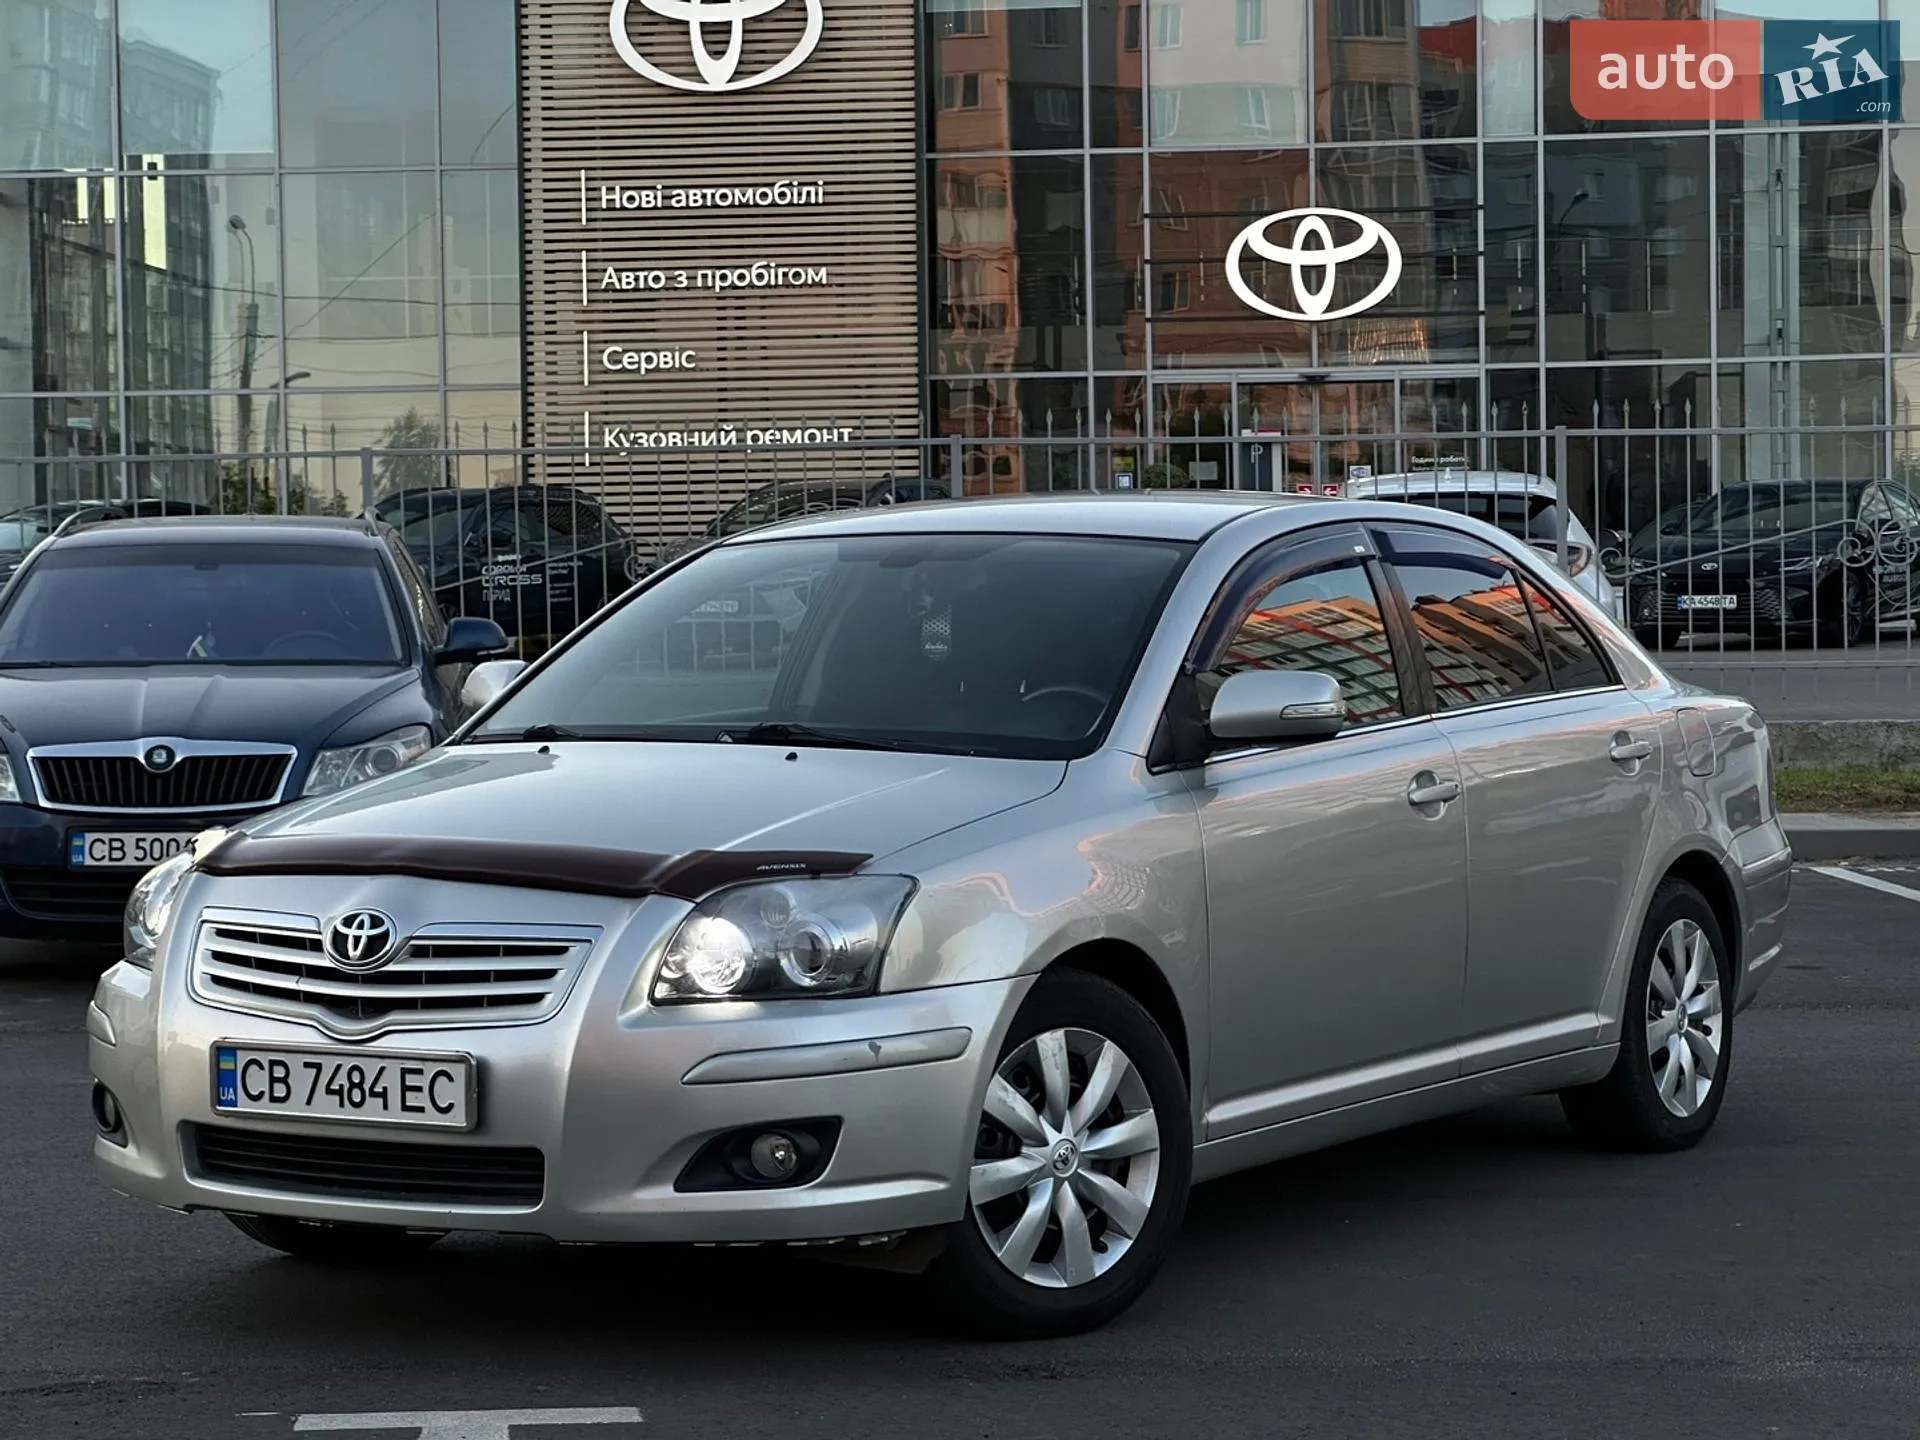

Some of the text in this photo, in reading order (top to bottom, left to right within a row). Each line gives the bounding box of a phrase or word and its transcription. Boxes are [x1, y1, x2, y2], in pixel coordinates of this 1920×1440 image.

[600, 179, 824, 209] Нові автомобілі
[601, 261, 828, 292] Авто з пробігом
[602, 346, 697, 375] Сервіс
[604, 423, 853, 456] Кузовний ремонт
[89, 837, 126, 862] CB
[220, 1086, 235, 1101] UA
[241, 1058, 455, 1114] CB 7484 EC
